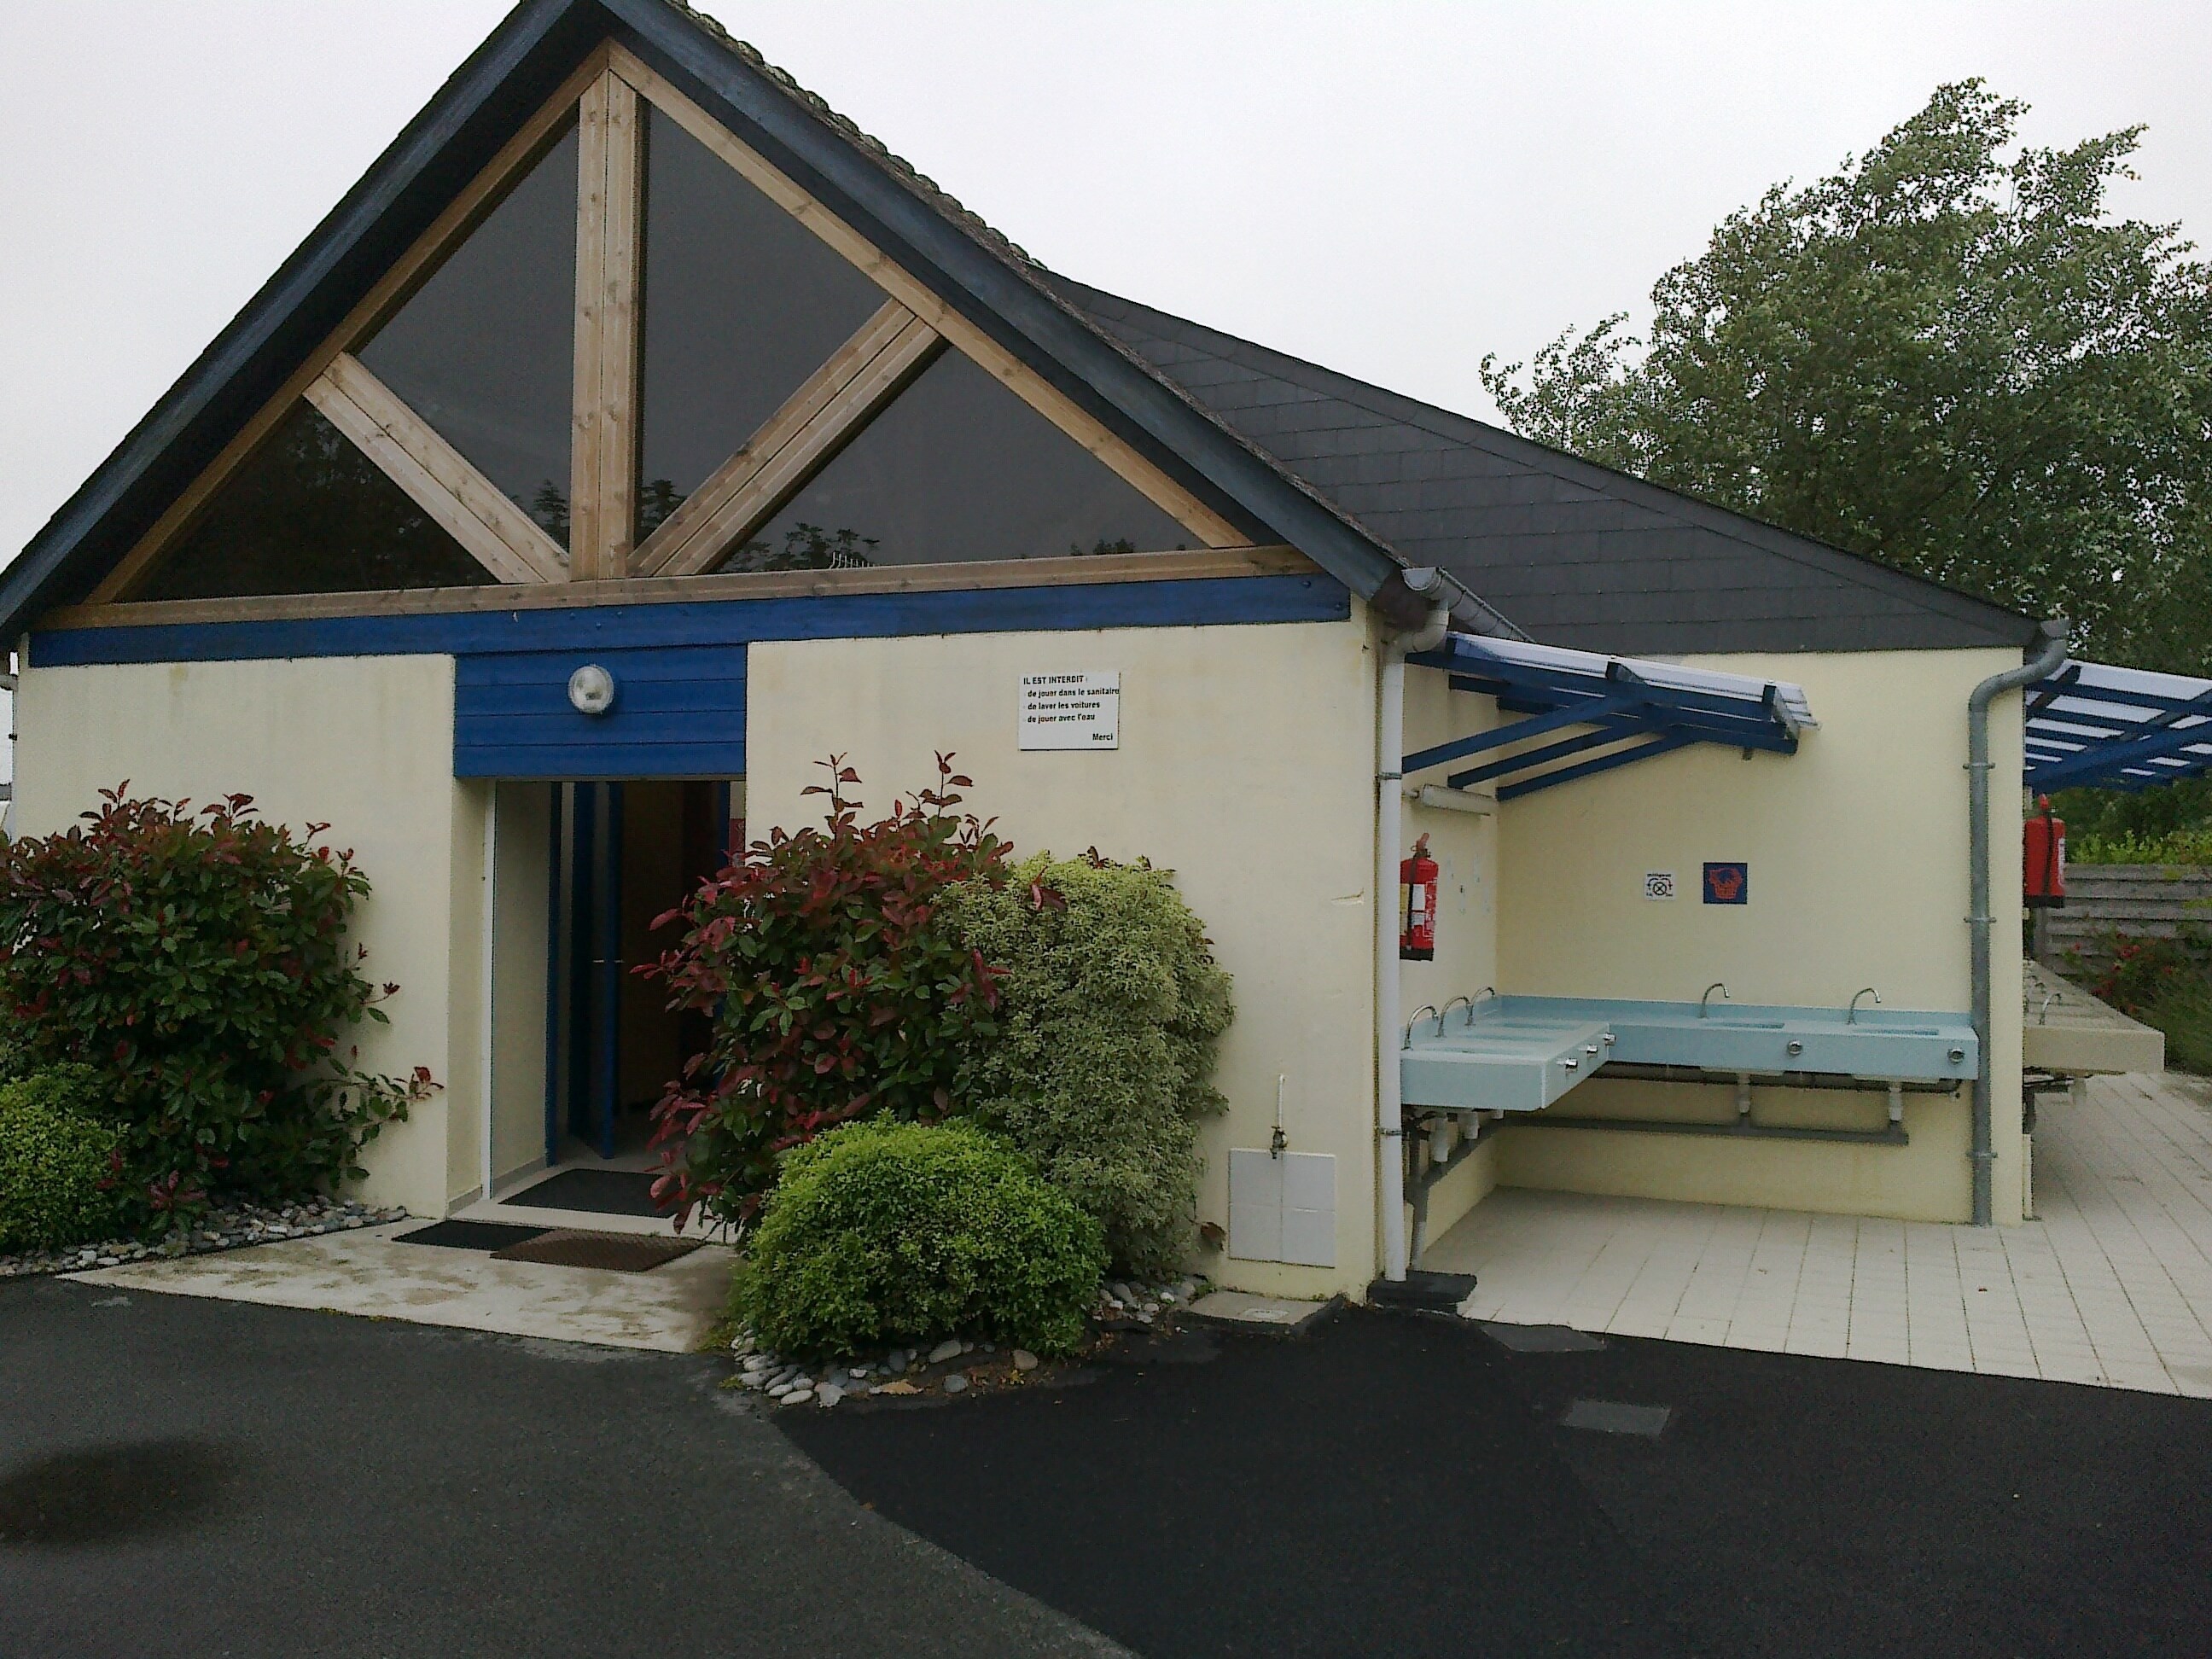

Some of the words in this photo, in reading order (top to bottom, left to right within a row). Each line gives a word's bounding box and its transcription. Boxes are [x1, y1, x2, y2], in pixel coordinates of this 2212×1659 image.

[1048, 675, 1085, 684] INTERDIT
[1038, 690, 1057, 699] jouer
[1038, 701, 1057, 710] laver
[1038, 715, 1057, 725] jouer
[1092, 732, 1114, 741] Merci
